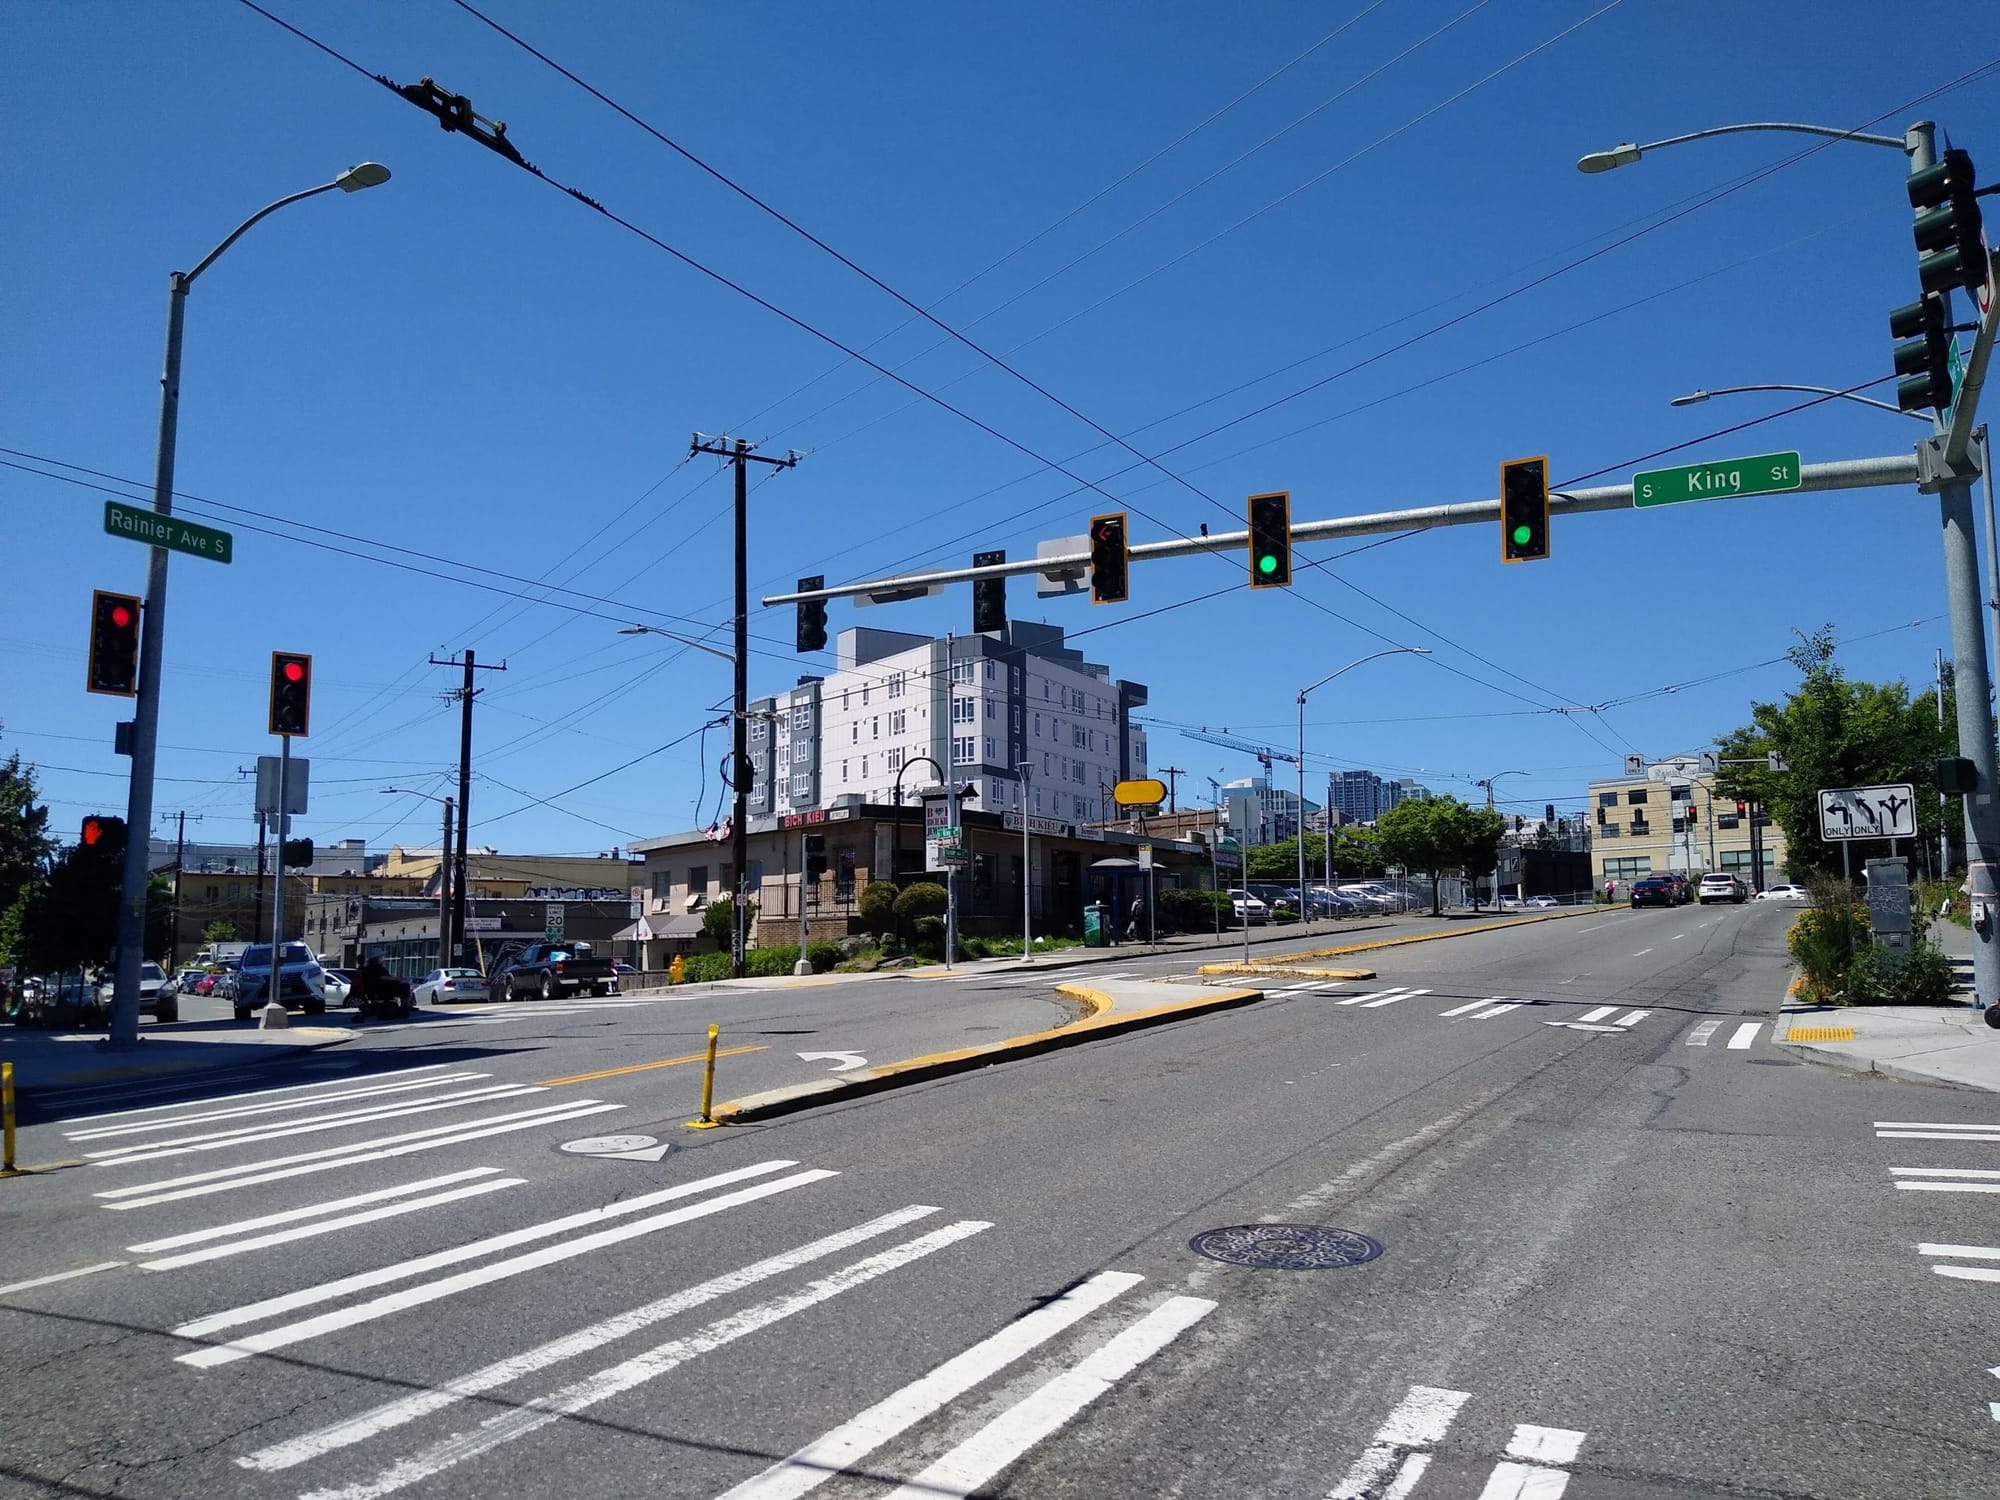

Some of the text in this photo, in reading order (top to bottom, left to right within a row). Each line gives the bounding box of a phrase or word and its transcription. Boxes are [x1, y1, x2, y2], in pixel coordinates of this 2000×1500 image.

[1642, 466, 1789, 498] S King St
[110, 509, 224, 554] Rainier Ave S
[784, 810, 825, 828] BICH KIEU
[1825, 827, 1850, 836] ONLY
[1854, 824, 1880, 834] ONLY
[548, 916, 563, 925] 20
